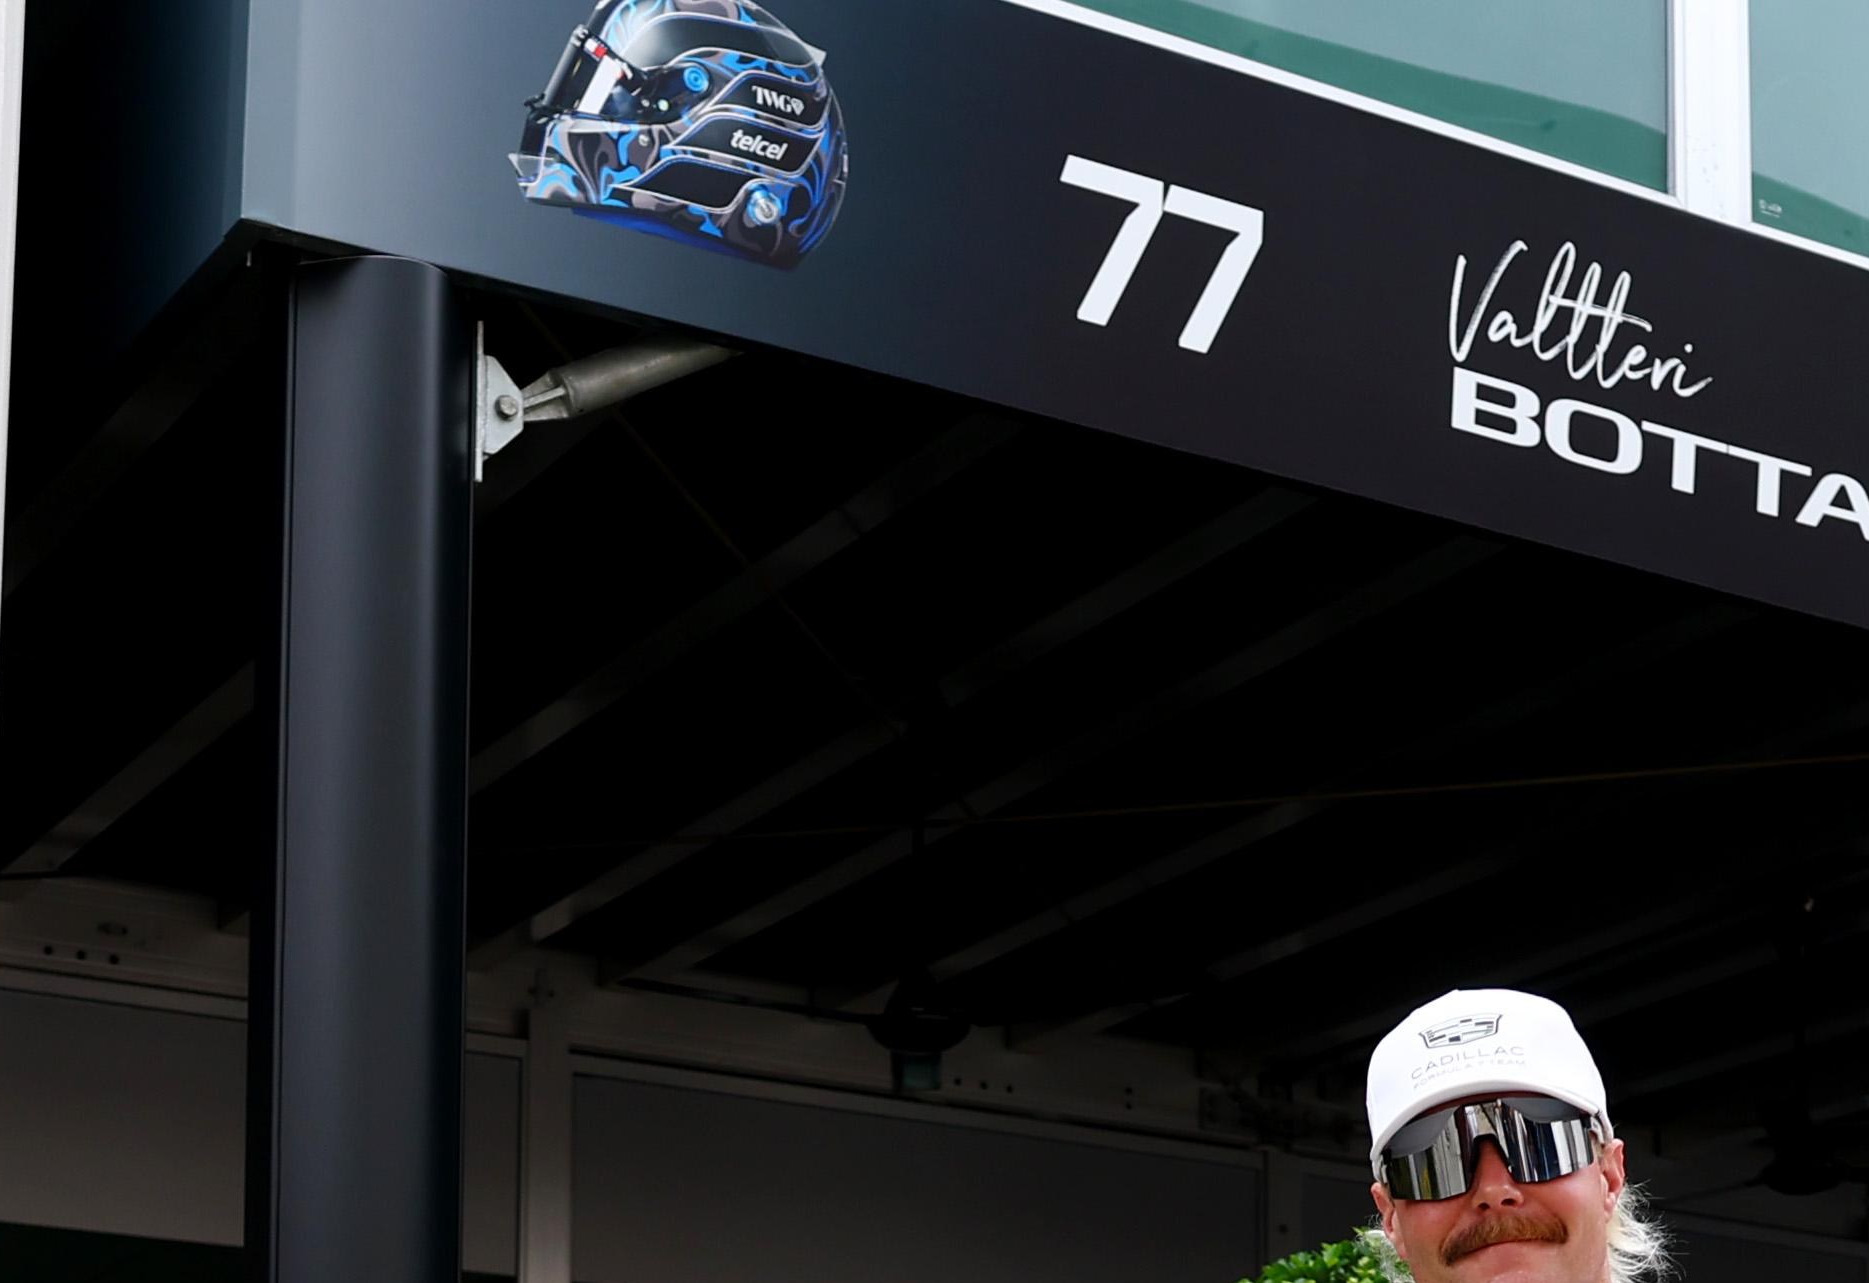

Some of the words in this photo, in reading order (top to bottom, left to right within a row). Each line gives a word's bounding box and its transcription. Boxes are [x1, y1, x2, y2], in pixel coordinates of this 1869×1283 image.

[730, 129, 788, 161] telcel
[1060, 154, 1263, 354] 77
[1449, 240, 1713, 398] Valtteri
[1411, 1046, 1525, 1080] CADILLAC
